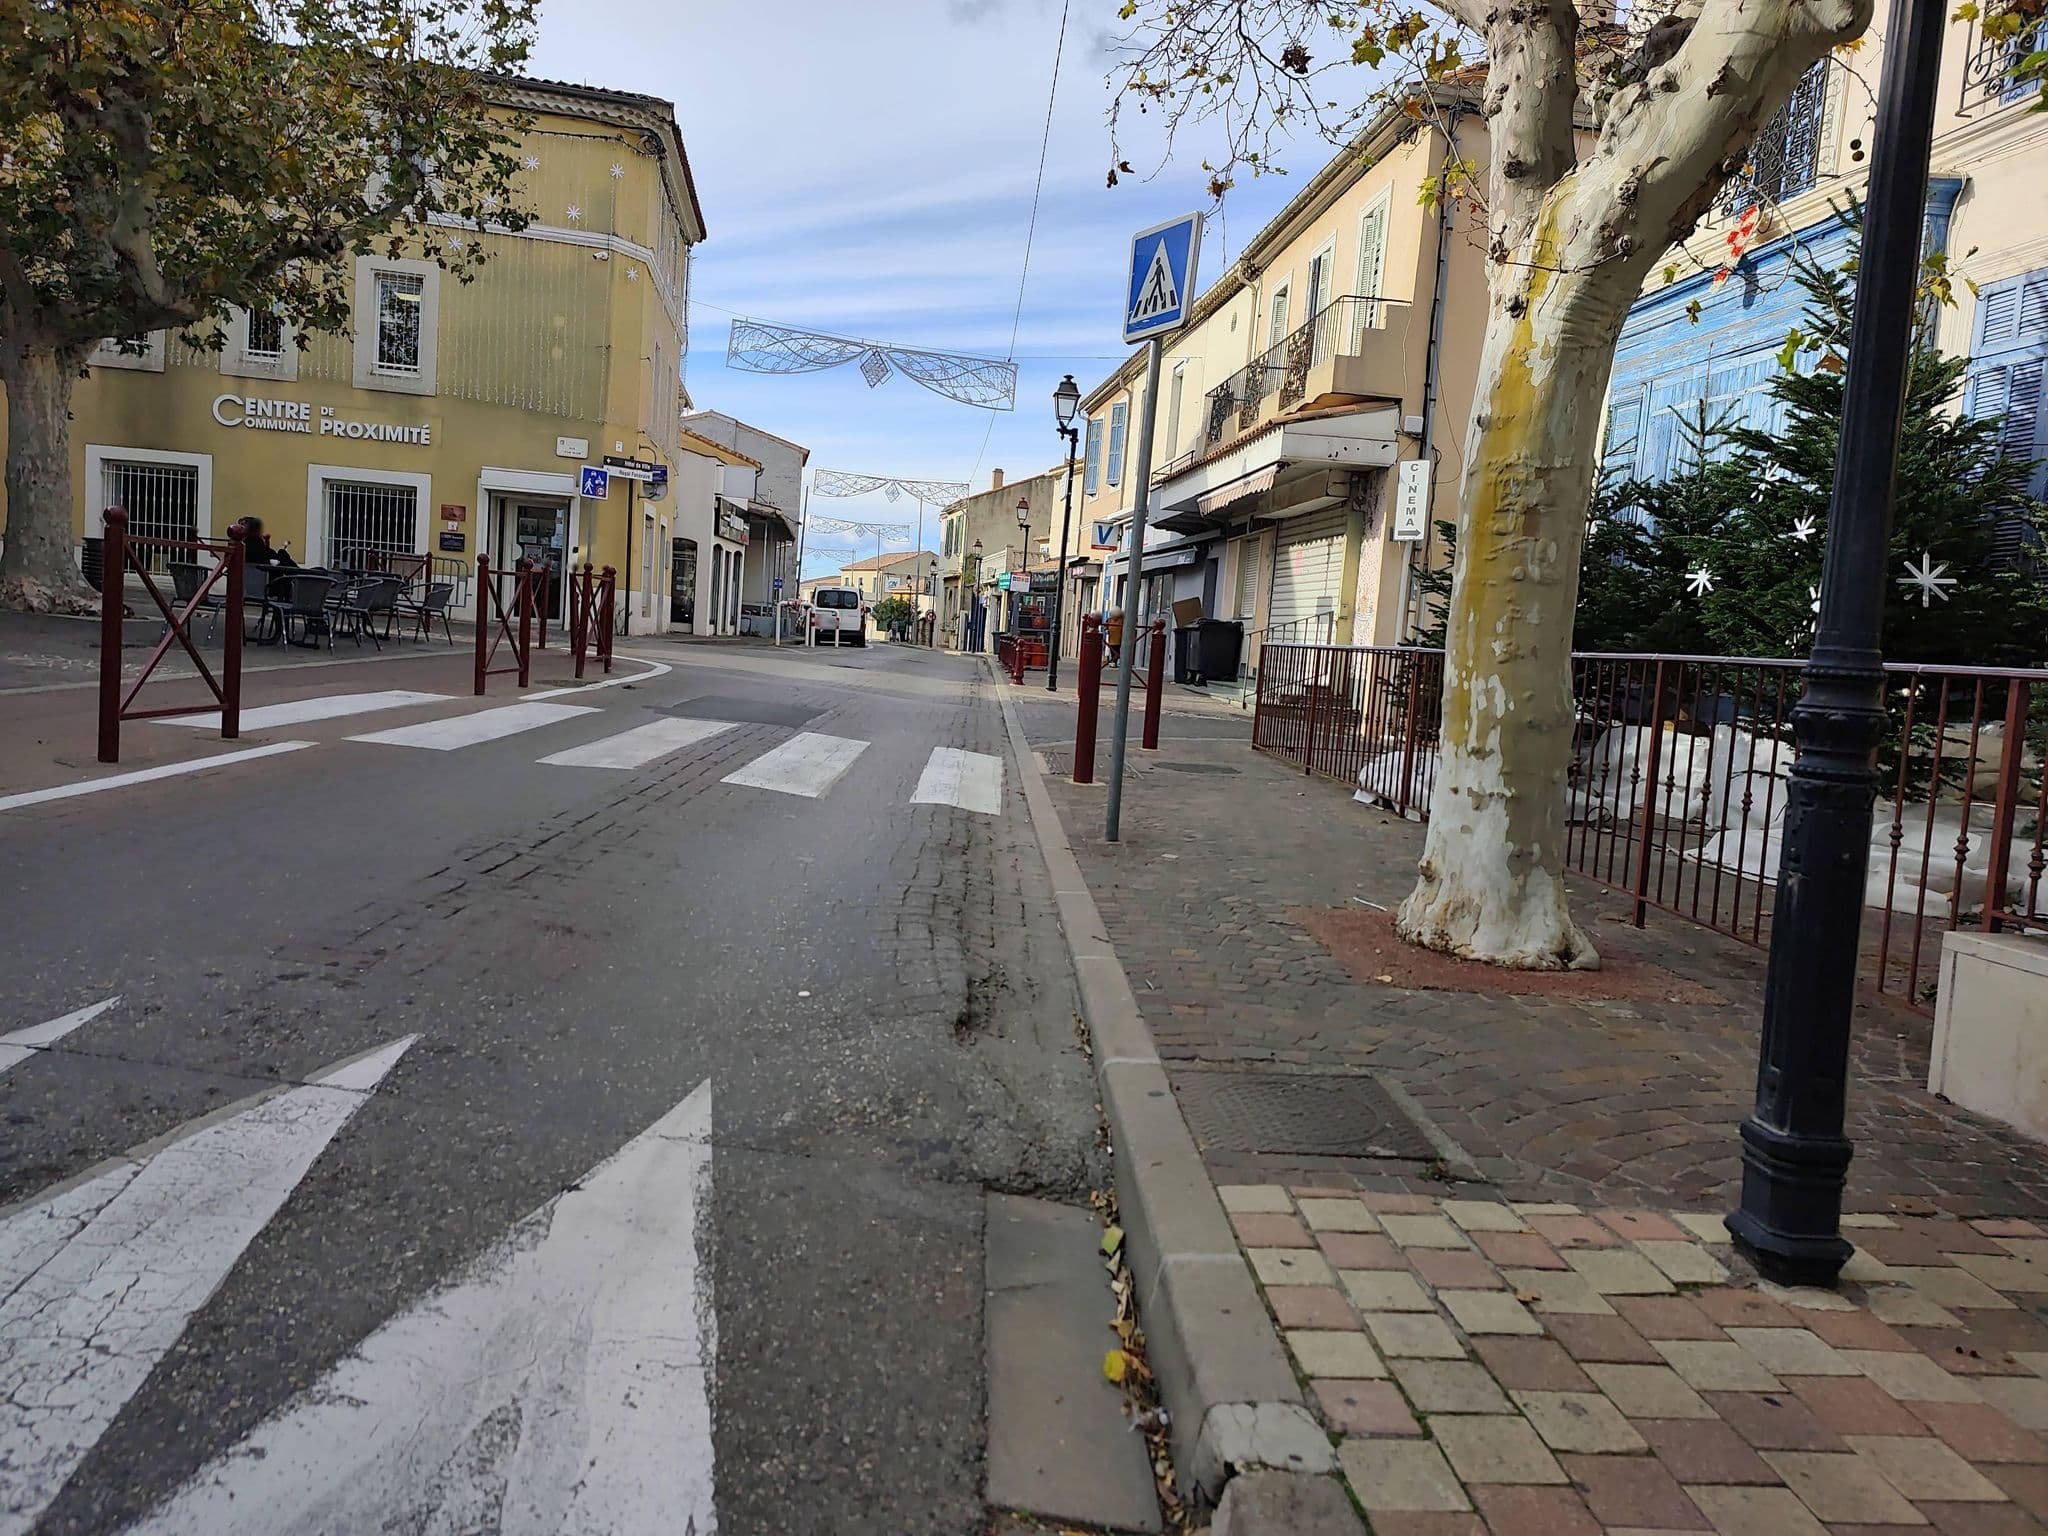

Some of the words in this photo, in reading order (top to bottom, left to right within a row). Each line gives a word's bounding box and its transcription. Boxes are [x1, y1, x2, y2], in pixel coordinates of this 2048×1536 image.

[320, 406, 335, 417] DE
[319, 418, 431, 445] PROXIMITÉ
[1405, 463, 1419, 526] CINEMA
